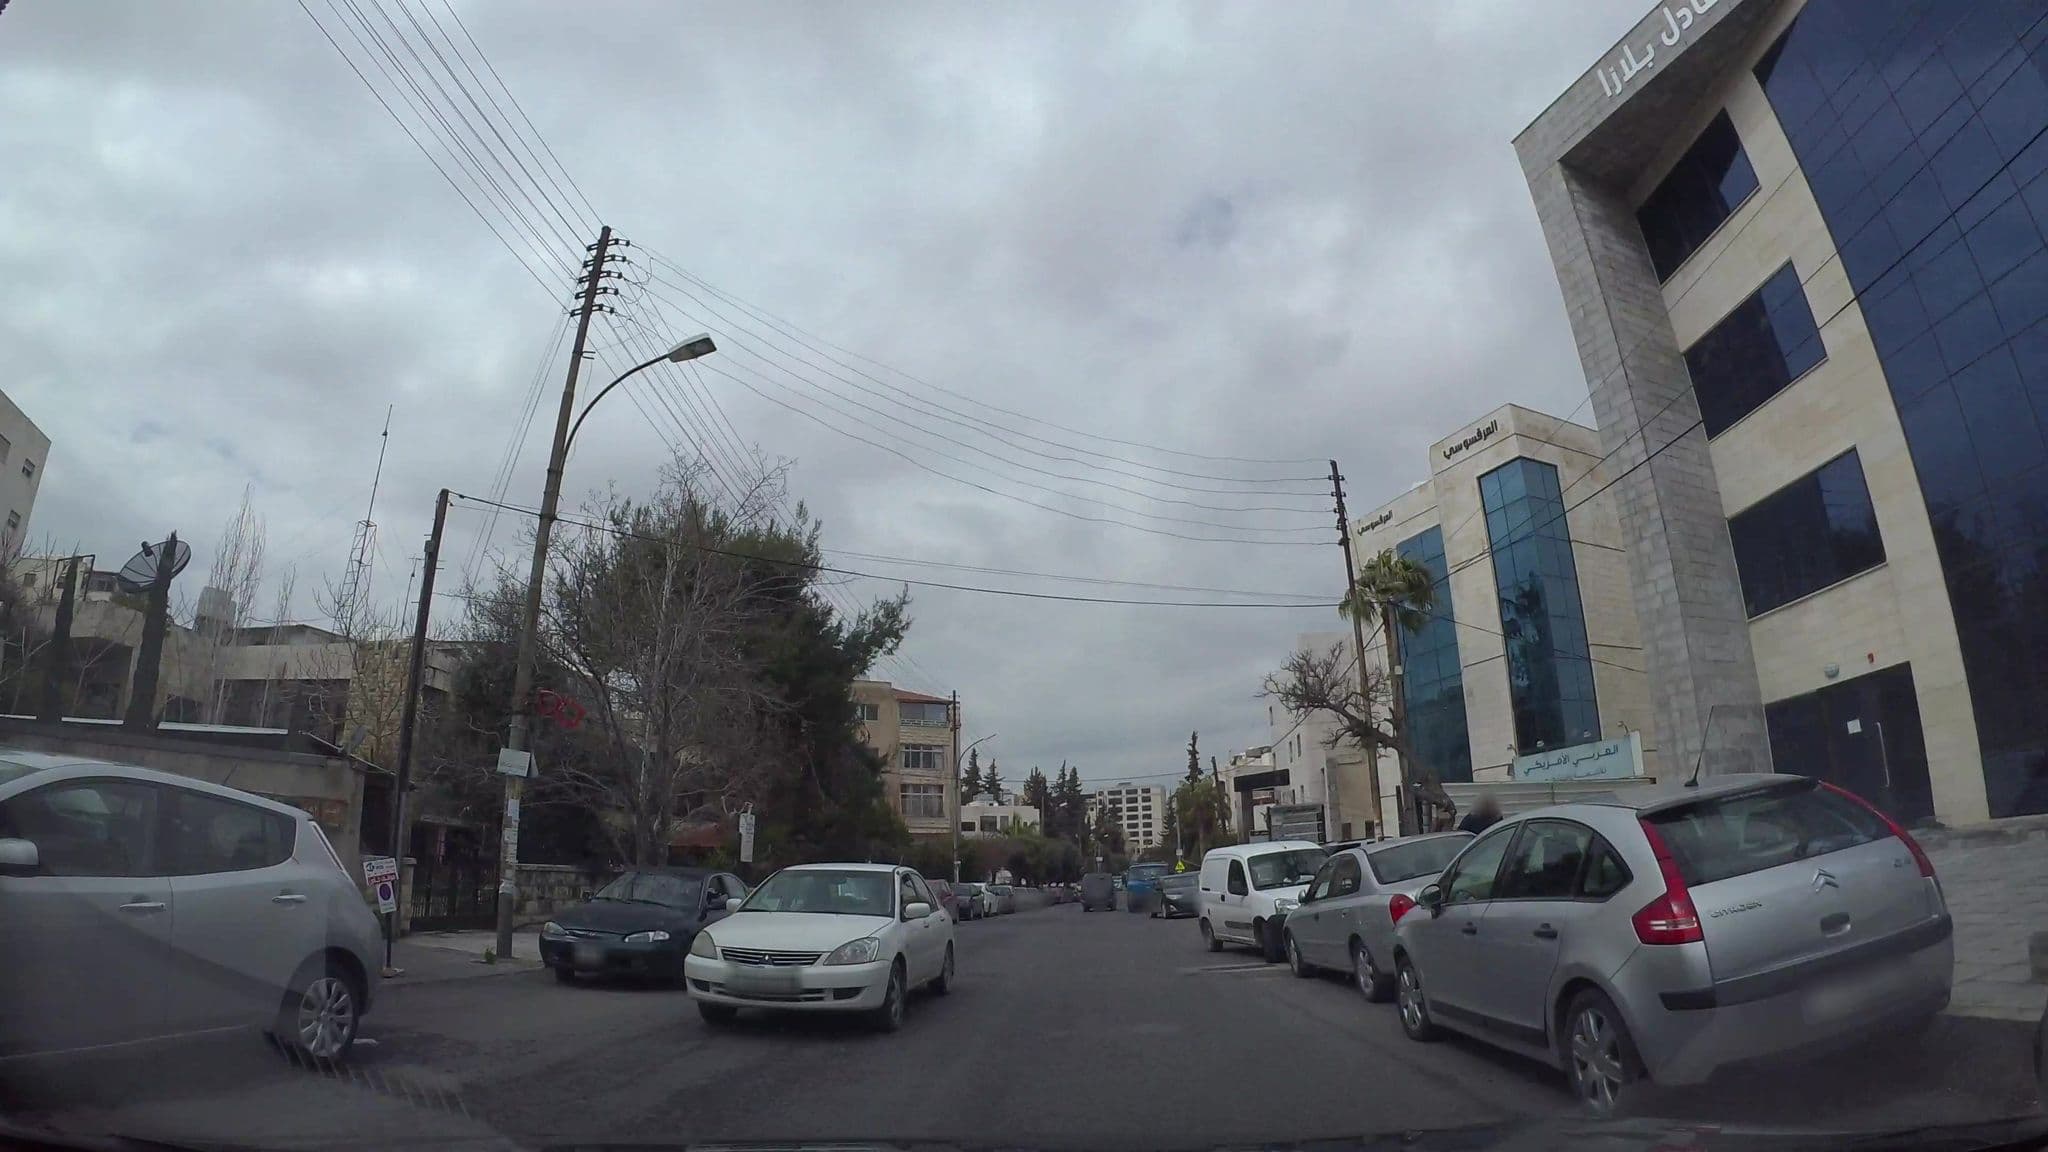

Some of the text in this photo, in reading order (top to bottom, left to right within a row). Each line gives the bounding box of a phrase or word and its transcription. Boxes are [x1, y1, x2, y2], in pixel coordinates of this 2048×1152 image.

[1597, 0, 1719, 97] دل بلازا
[1572, 744, 1619, 768] العربي
